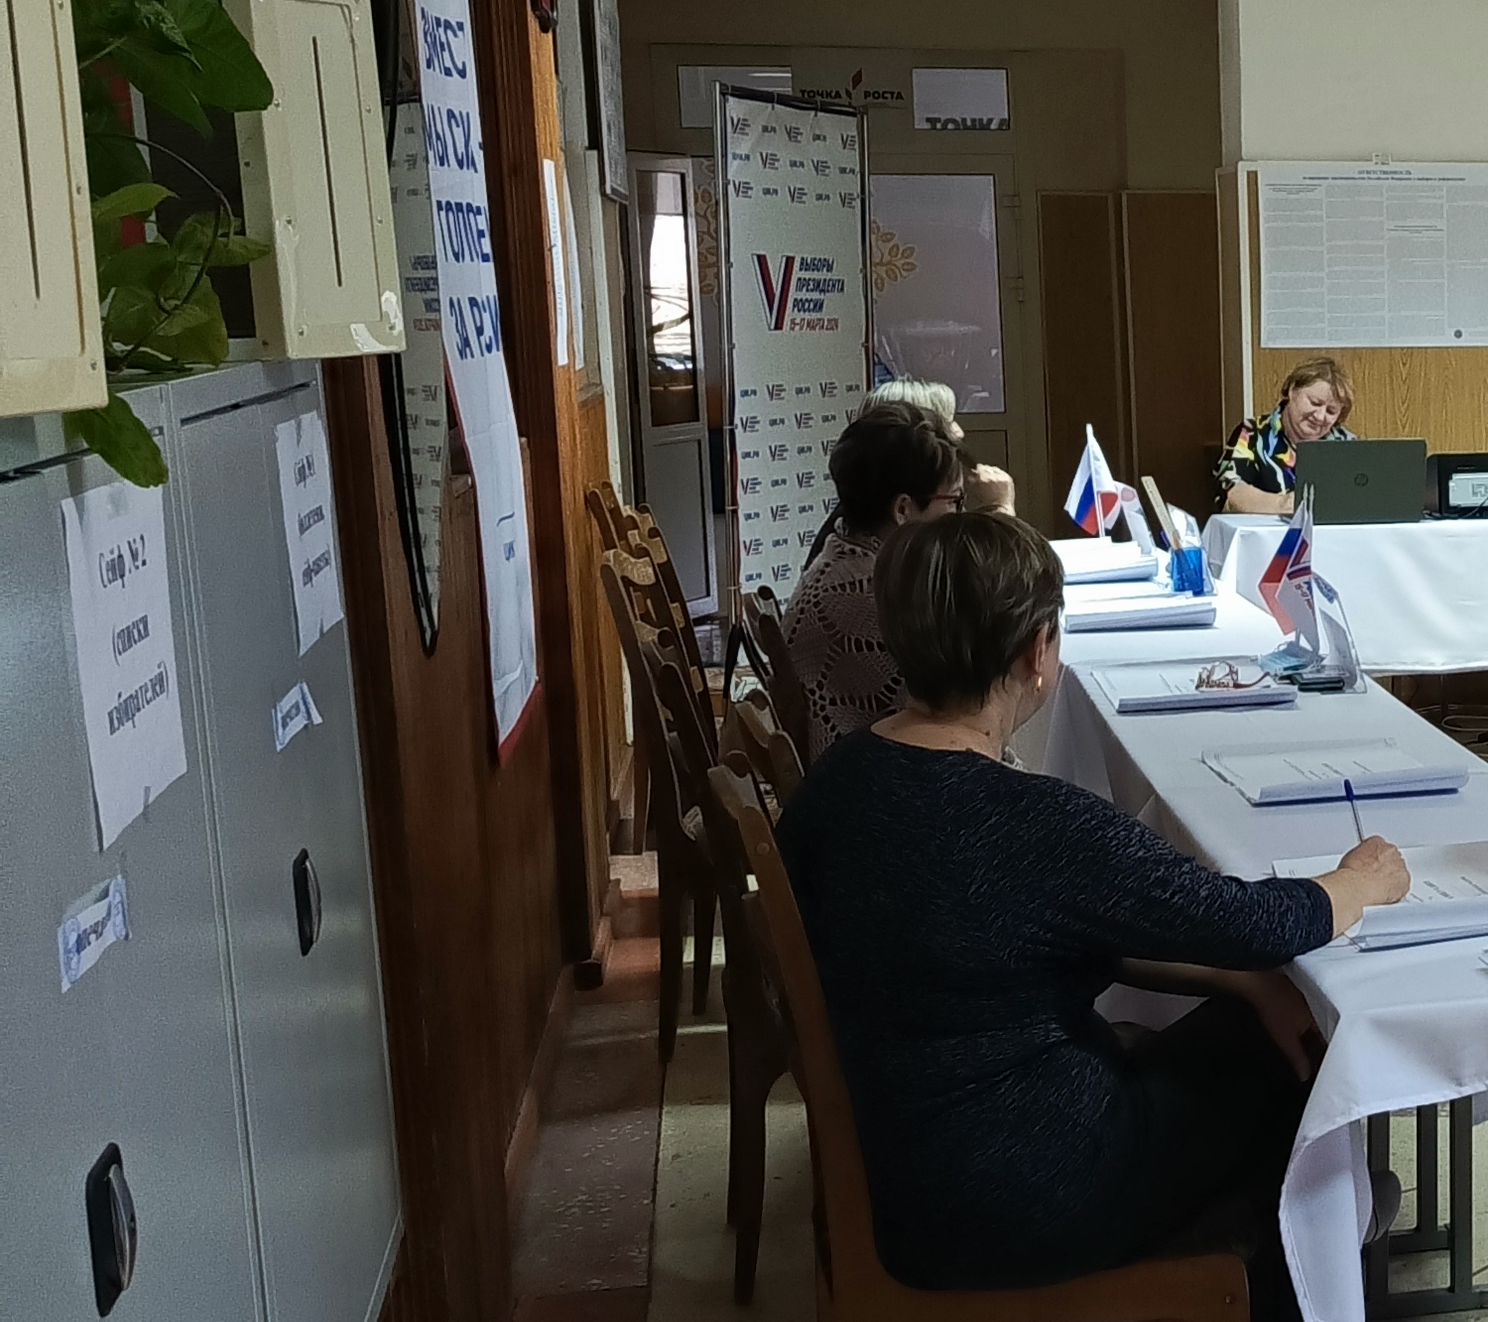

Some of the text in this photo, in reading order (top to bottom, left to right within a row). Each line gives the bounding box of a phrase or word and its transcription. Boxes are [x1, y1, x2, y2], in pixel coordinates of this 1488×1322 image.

[800, 89, 904, 100] ТОЧКА РОСТА
[798, 257, 834, 273] ВЫБОРЫ
[795, 277, 845, 295] ПРЕЗИДЕНТА
[792, 298, 825, 313] РОССИИ
[99, 544, 126, 589] Сейф
[112, 614, 150, 667] (списки
[107, 660, 169, 737] избирателей)
